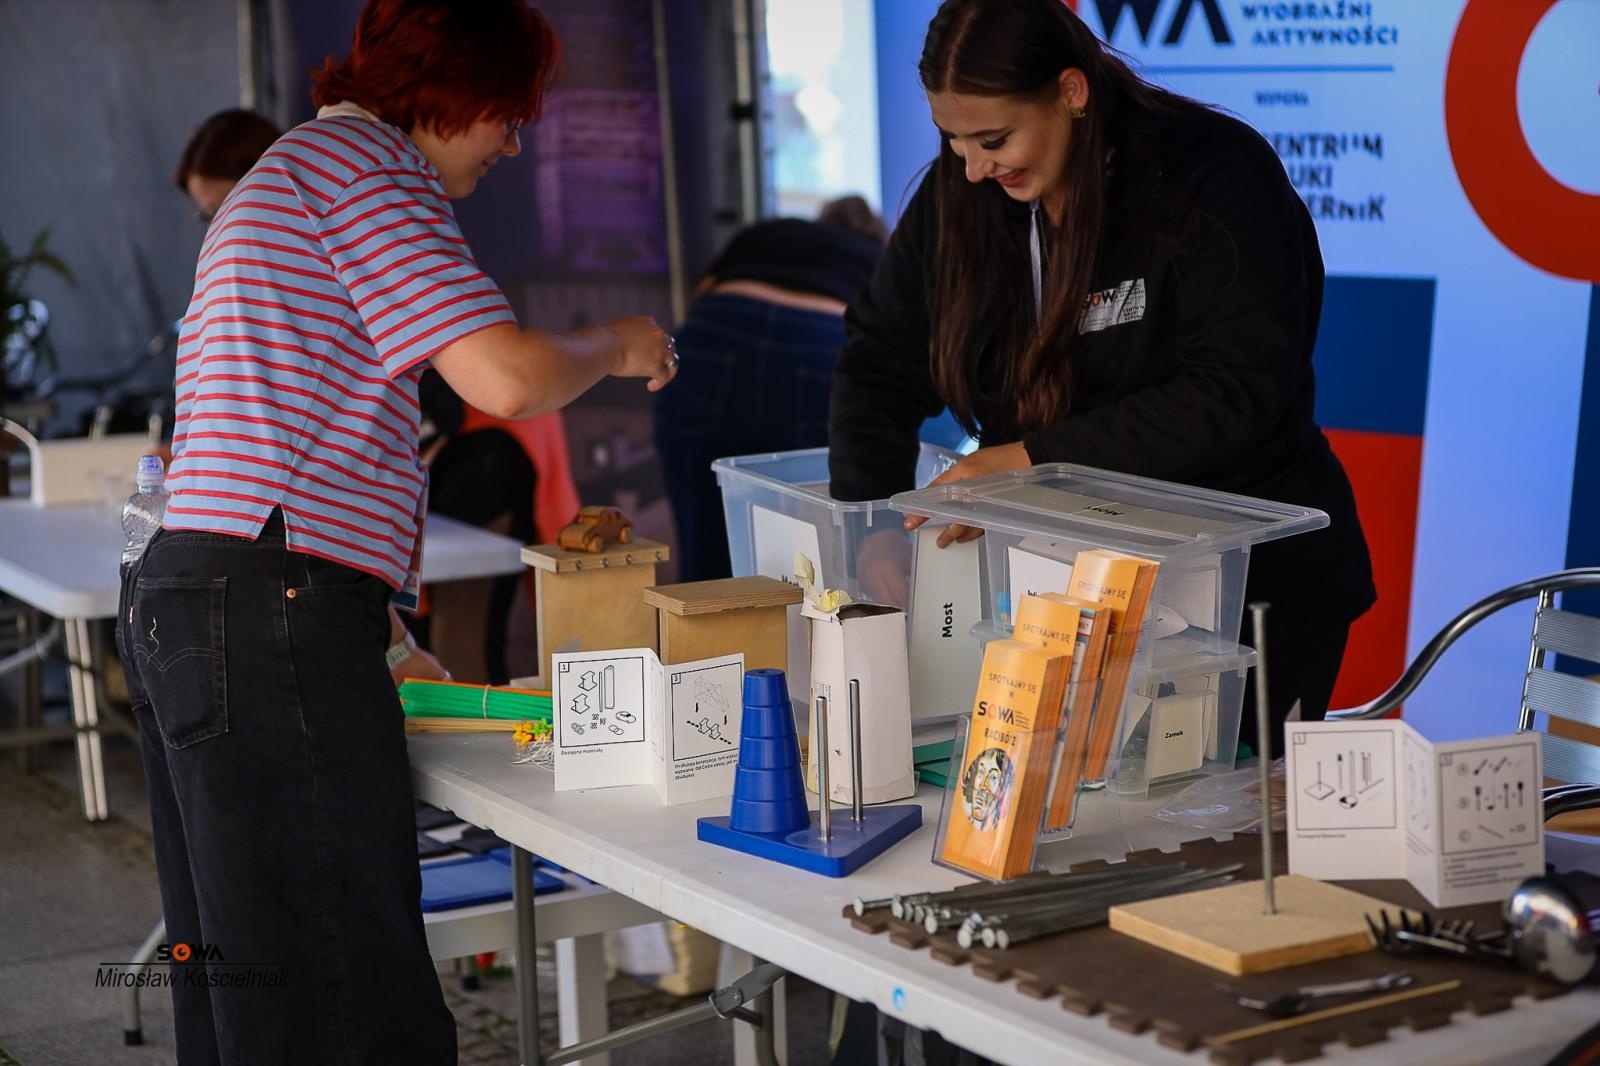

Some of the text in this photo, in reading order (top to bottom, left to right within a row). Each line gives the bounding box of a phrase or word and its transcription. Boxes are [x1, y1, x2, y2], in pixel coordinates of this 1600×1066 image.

[1252, 25, 1398, 46] AKTYWNOŚCI
[1265, 133, 1383, 159] ENTRUM
[942, 602, 953, 638] Most
[977, 700, 1015, 726] SOWA
[1165, 730, 1184, 739] Zamek
